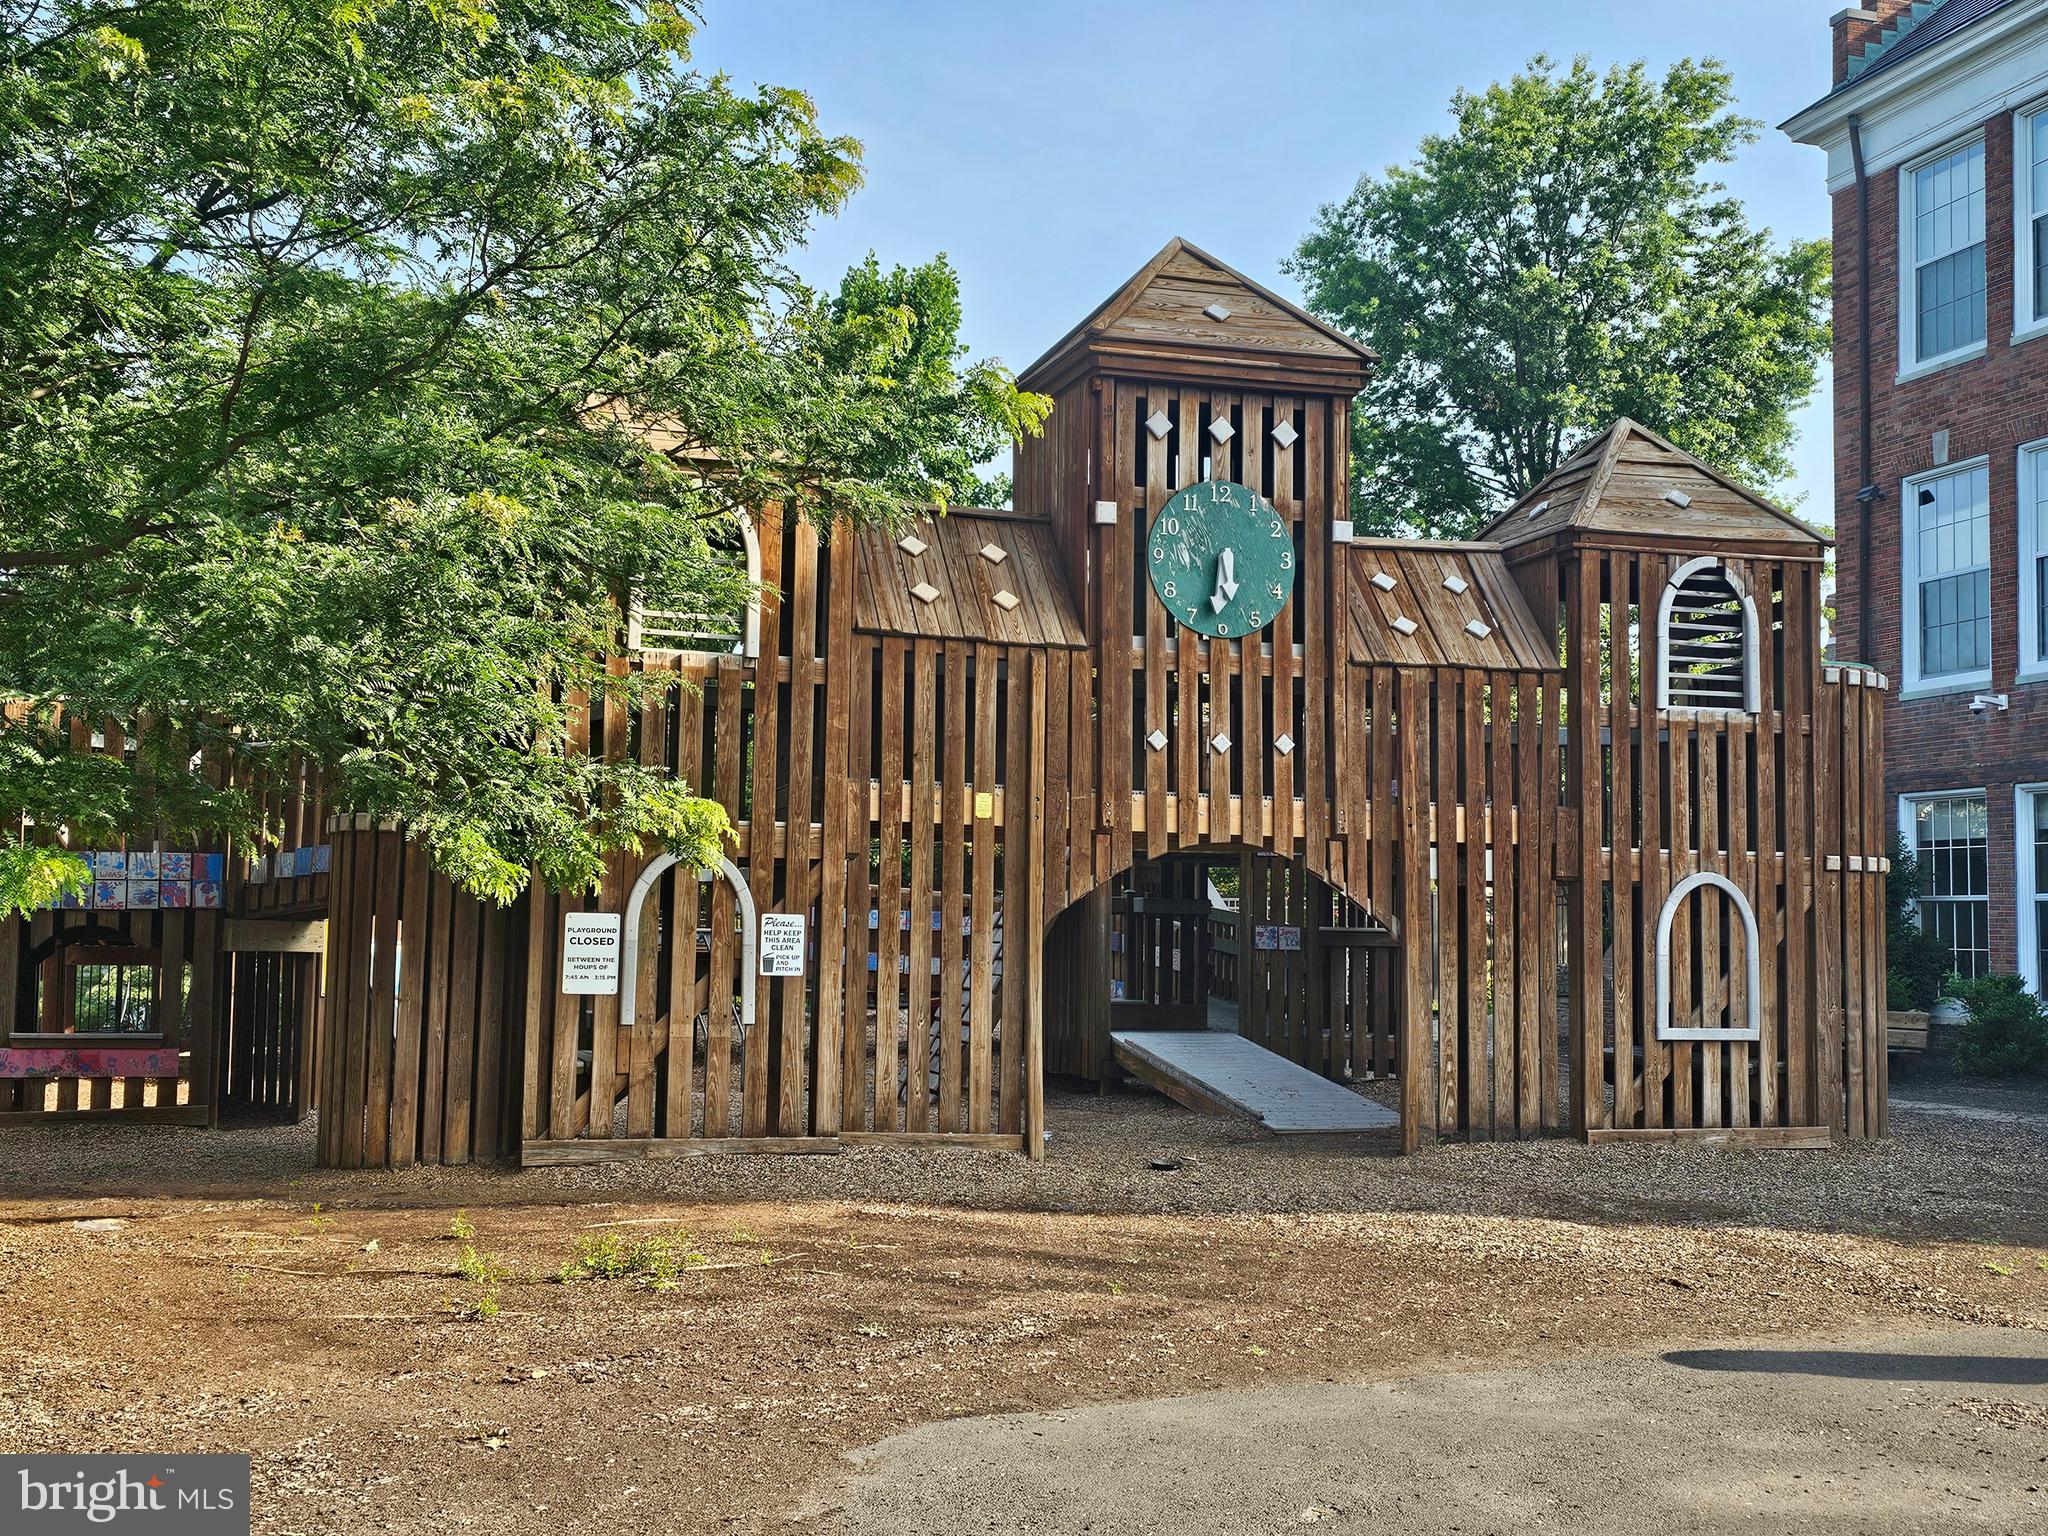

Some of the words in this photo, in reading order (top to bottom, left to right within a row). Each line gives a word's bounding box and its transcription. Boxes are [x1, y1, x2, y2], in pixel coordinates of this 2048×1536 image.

[1211, 486, 1231, 502] 12
[1184, 494, 1198, 511] 11
[1250, 495, 1258, 511] 1
[1160, 518, 1179, 535] 10
[1270, 521, 1282, 538] 2
[1153, 548, 1164, 564] 9
[1280, 552, 1292, 569] 3
[1164, 582, 1176, 597] 8
[1272, 583, 1283, 599] 4
[1187, 608, 1198, 624] 7
[1250, 612, 1261, 628] 5
[569, 936, 615, 946] CLOSED
